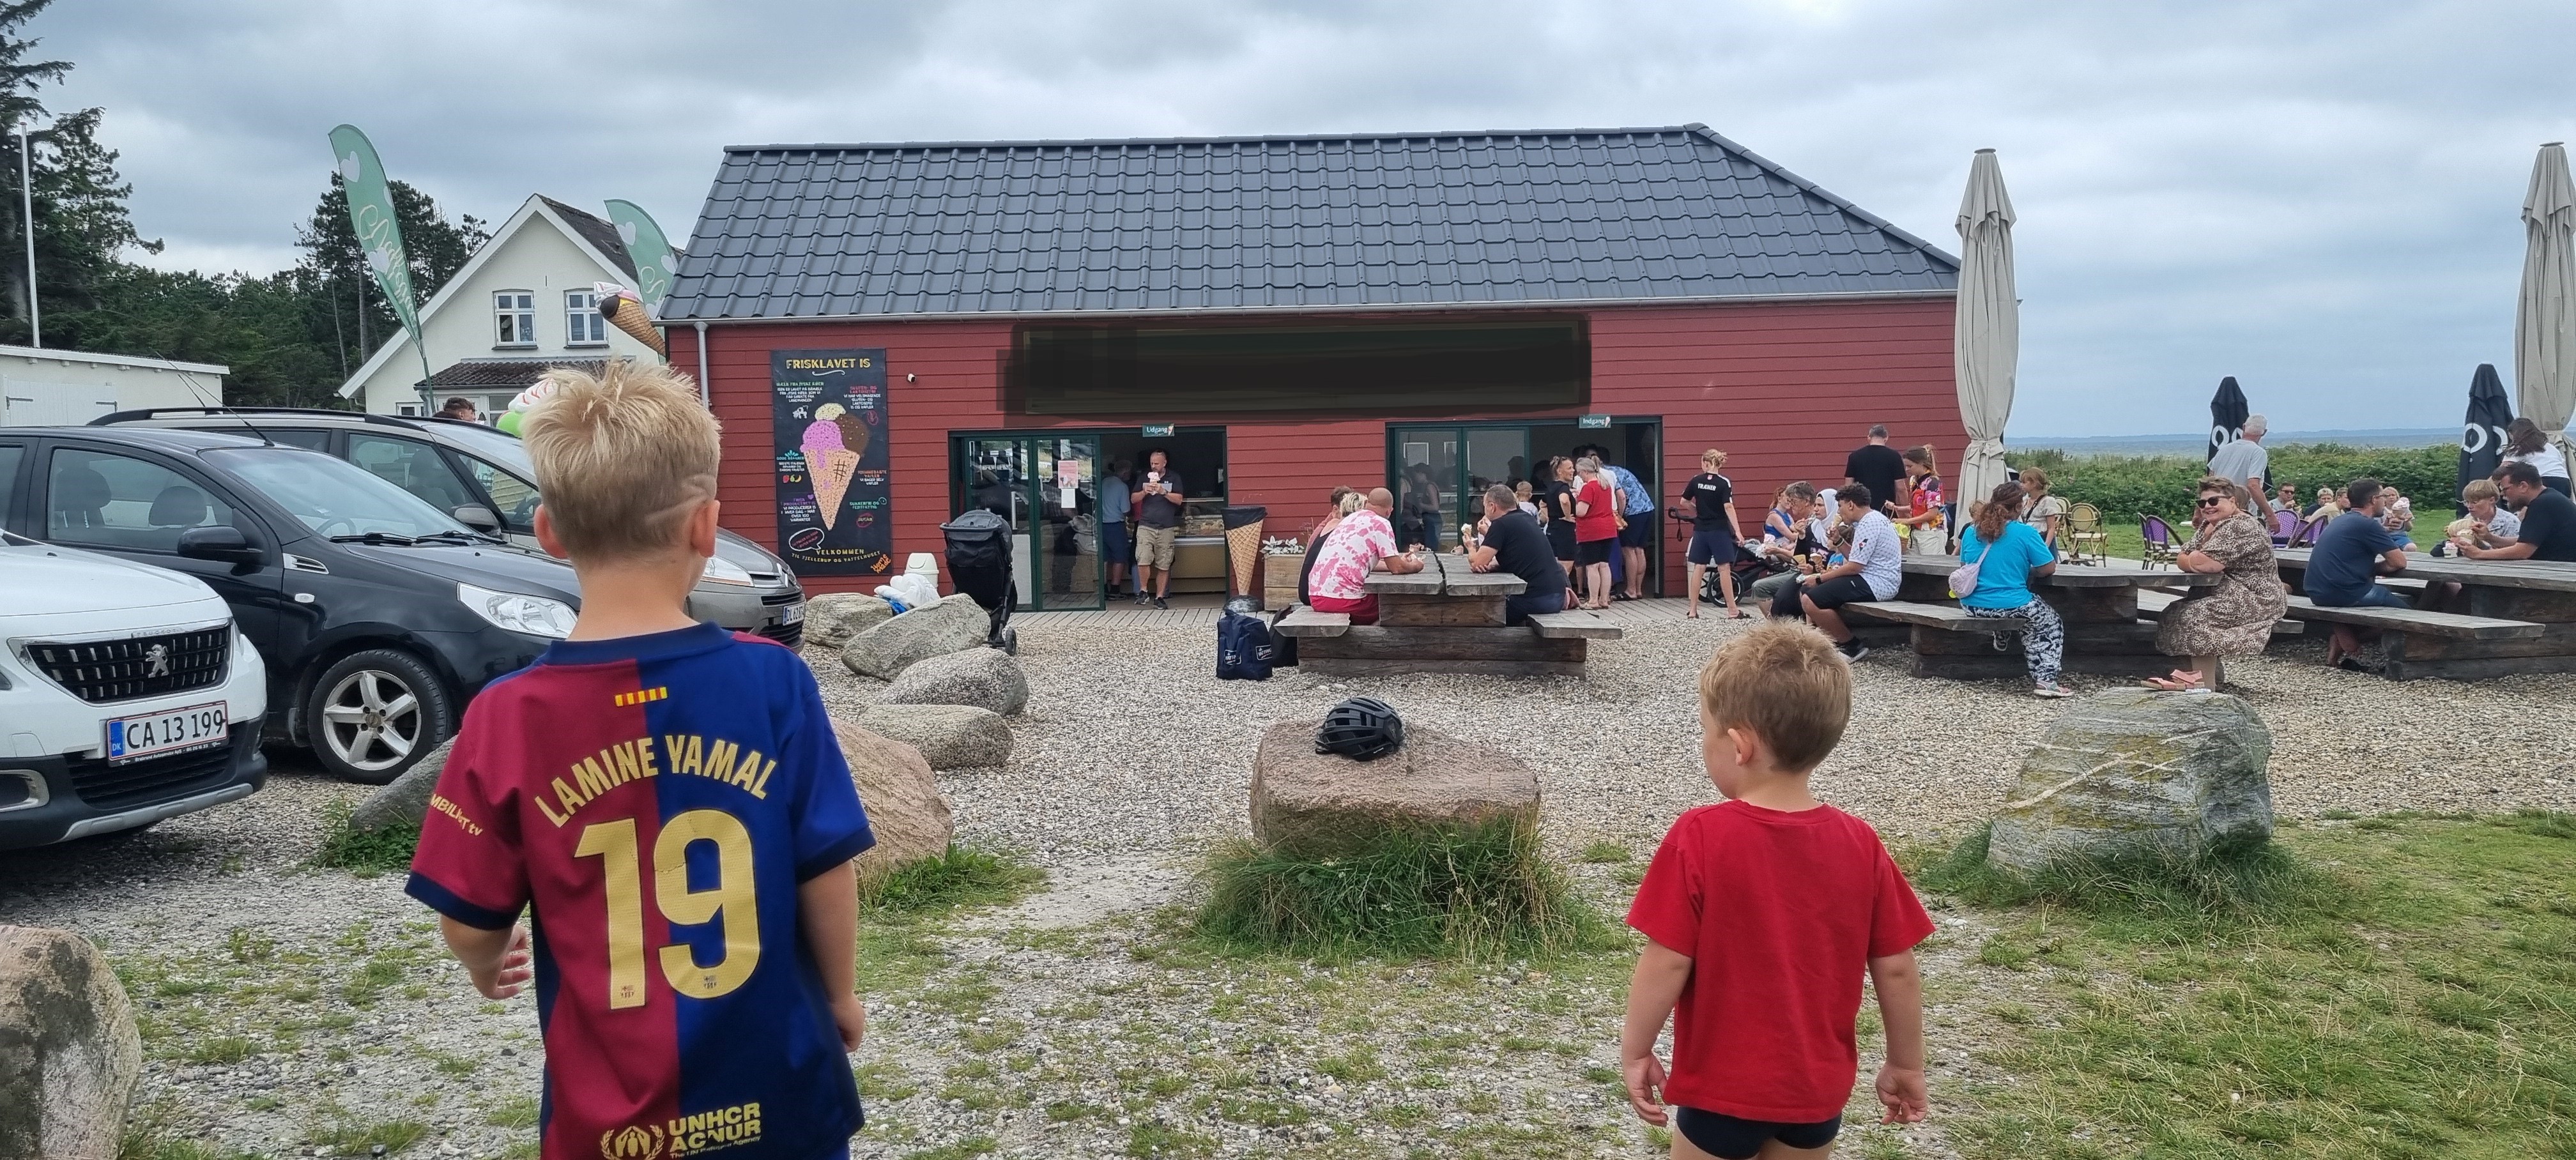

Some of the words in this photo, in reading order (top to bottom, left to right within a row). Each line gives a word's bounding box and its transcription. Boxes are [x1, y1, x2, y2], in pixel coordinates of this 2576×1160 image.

[786, 358, 856, 369] FRISKLAVET
[859, 358, 871, 368] IS
[1583, 417, 1606, 425] Indgang
[126, 721, 156, 749] CA
[162, 716, 185, 744] 13
[191, 709, 224, 738] 199
[112, 742, 121, 751] DK
[534, 736, 659, 828] LAMINE
[665, 734, 777, 800] YAMAL
[468, 823, 484, 836] tv
[574, 809, 763, 1011] 19
[669, 1102, 762, 1137] UNHCR
